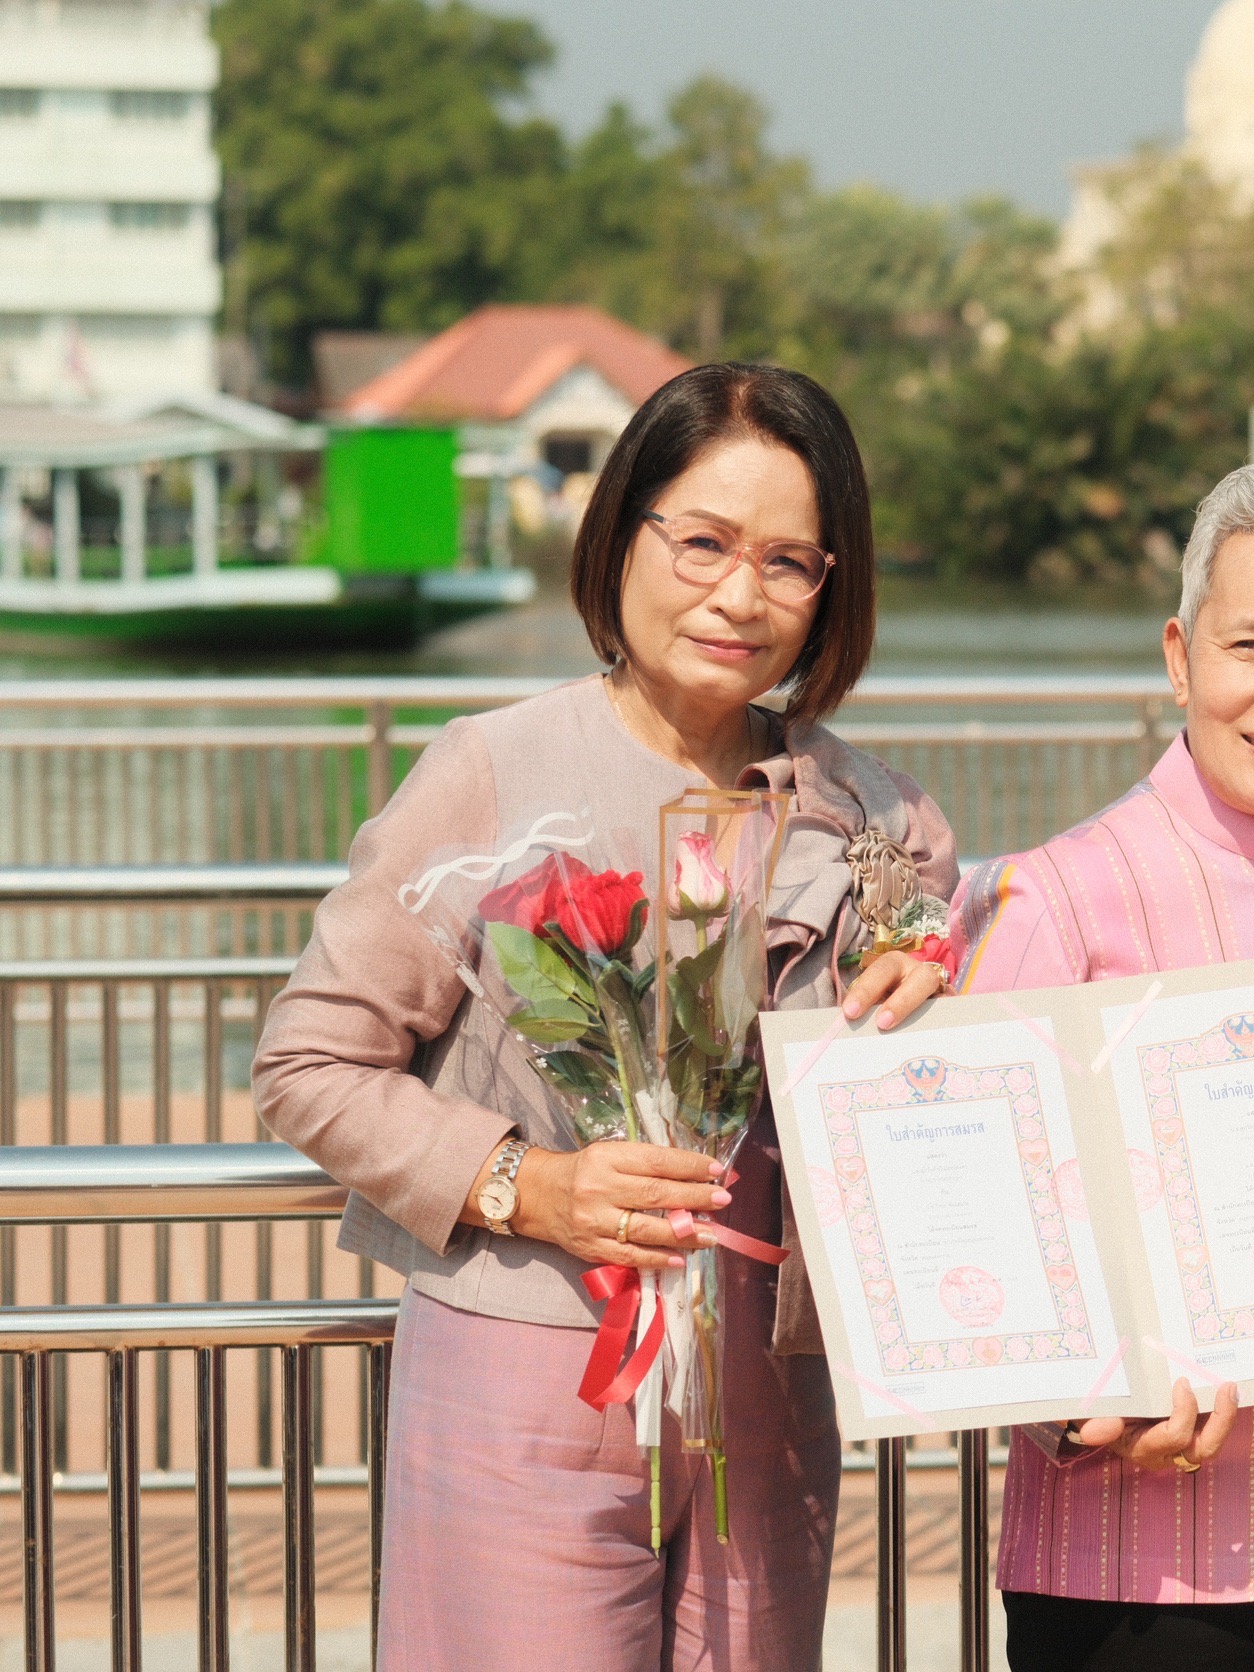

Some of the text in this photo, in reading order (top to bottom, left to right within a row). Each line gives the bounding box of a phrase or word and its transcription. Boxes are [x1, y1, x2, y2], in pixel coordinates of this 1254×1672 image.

[886, 1121, 985, 1143] ใบสำคัญการสมรส
